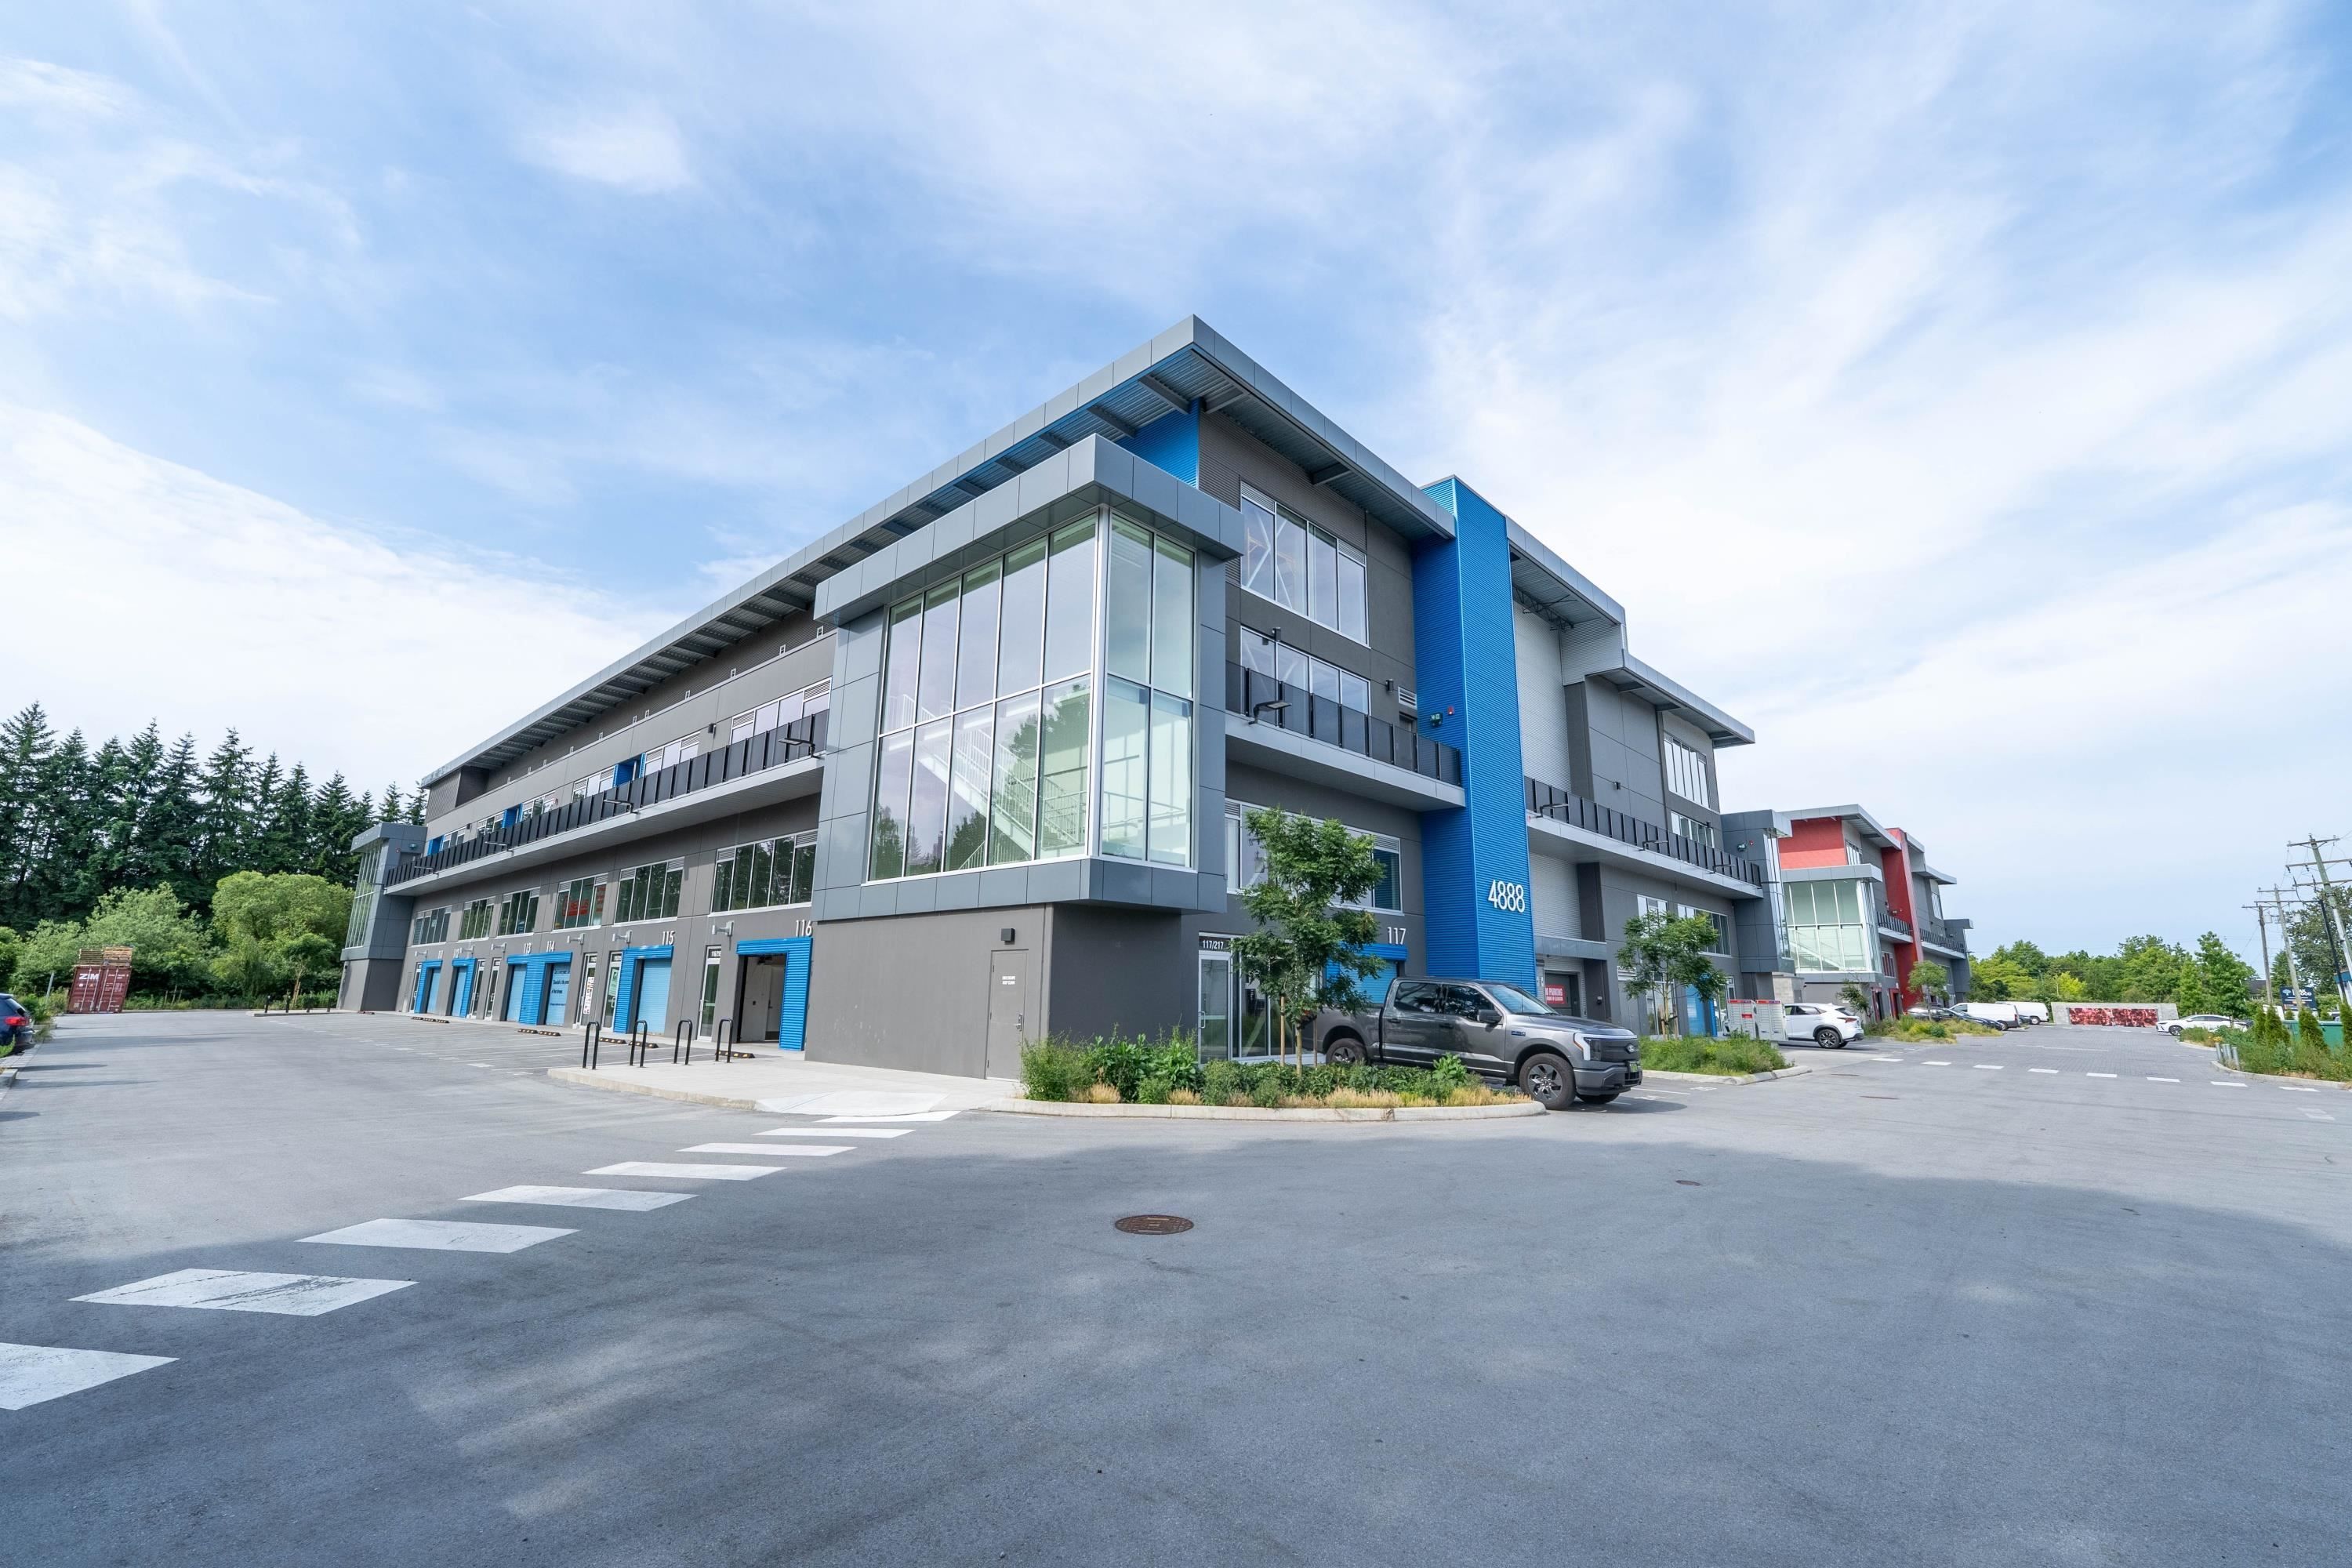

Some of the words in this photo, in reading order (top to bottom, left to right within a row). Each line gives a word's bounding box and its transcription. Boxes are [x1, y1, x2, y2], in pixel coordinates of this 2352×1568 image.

[1488, 879, 1525, 913] 4888
[796, 920, 812, 937] 116
[662, 931, 674, 946] 115
[1387, 927, 1406, 945] 117
[523, 942, 532, 954] 113
[546, 941, 555, 953] 114
[1203, 940, 1224, 949] 117/217
[1549, 988, 1563, 996] PARKING
